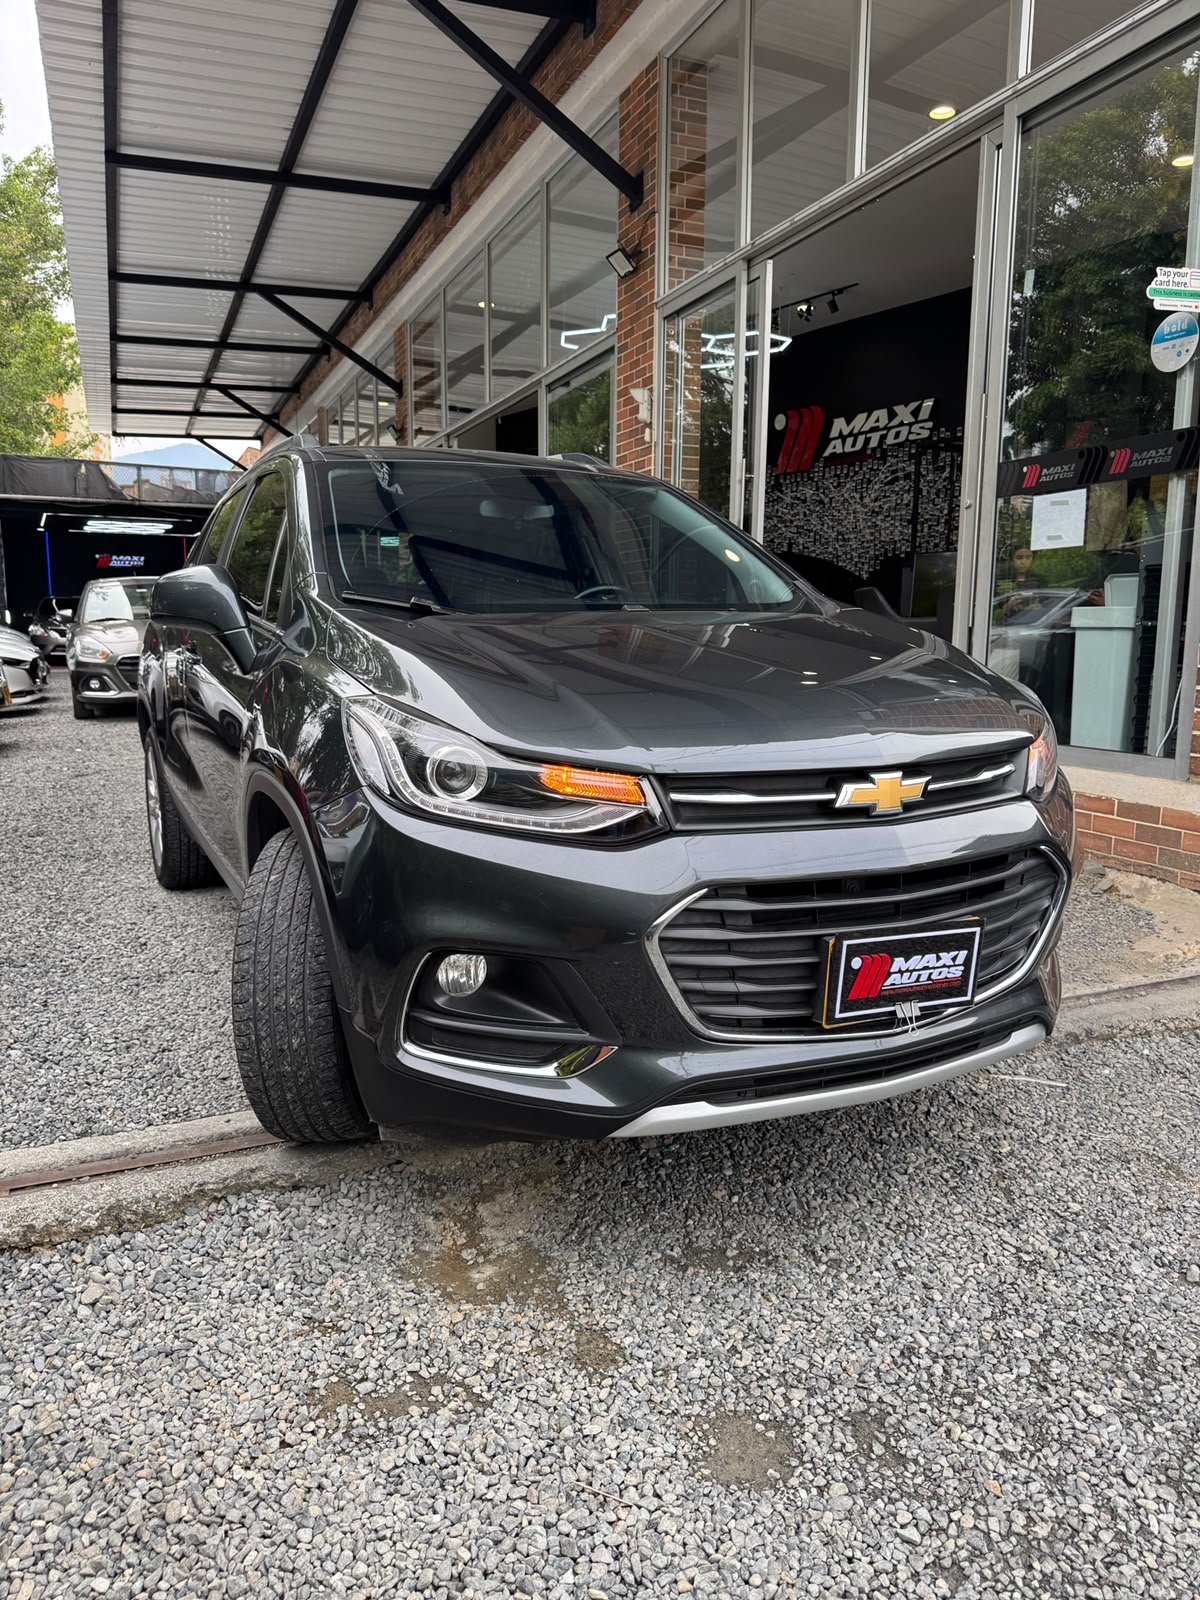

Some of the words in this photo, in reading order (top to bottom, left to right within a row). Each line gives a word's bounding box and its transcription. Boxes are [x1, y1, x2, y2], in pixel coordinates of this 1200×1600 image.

[1159, 269, 1171, 278] Tap
[1173, 271, 1188, 279] your
[1155, 279, 1171, 287] card
[1172, 280, 1189, 288] here.
[1163, 317, 1188, 335] bold
[829, 398, 935, 438] MAXI
[823, 421, 933, 457] AUTOS
[1132, 447, 1174, 460] MAXI
[1129, 455, 1172, 467] AUTOS
[1041, 464, 1076, 475] MAXI
[1039, 472, 1074, 482] AUTOS
[890, 950, 968, 972] MAXI
[883, 966, 964, 986] AUTOS
